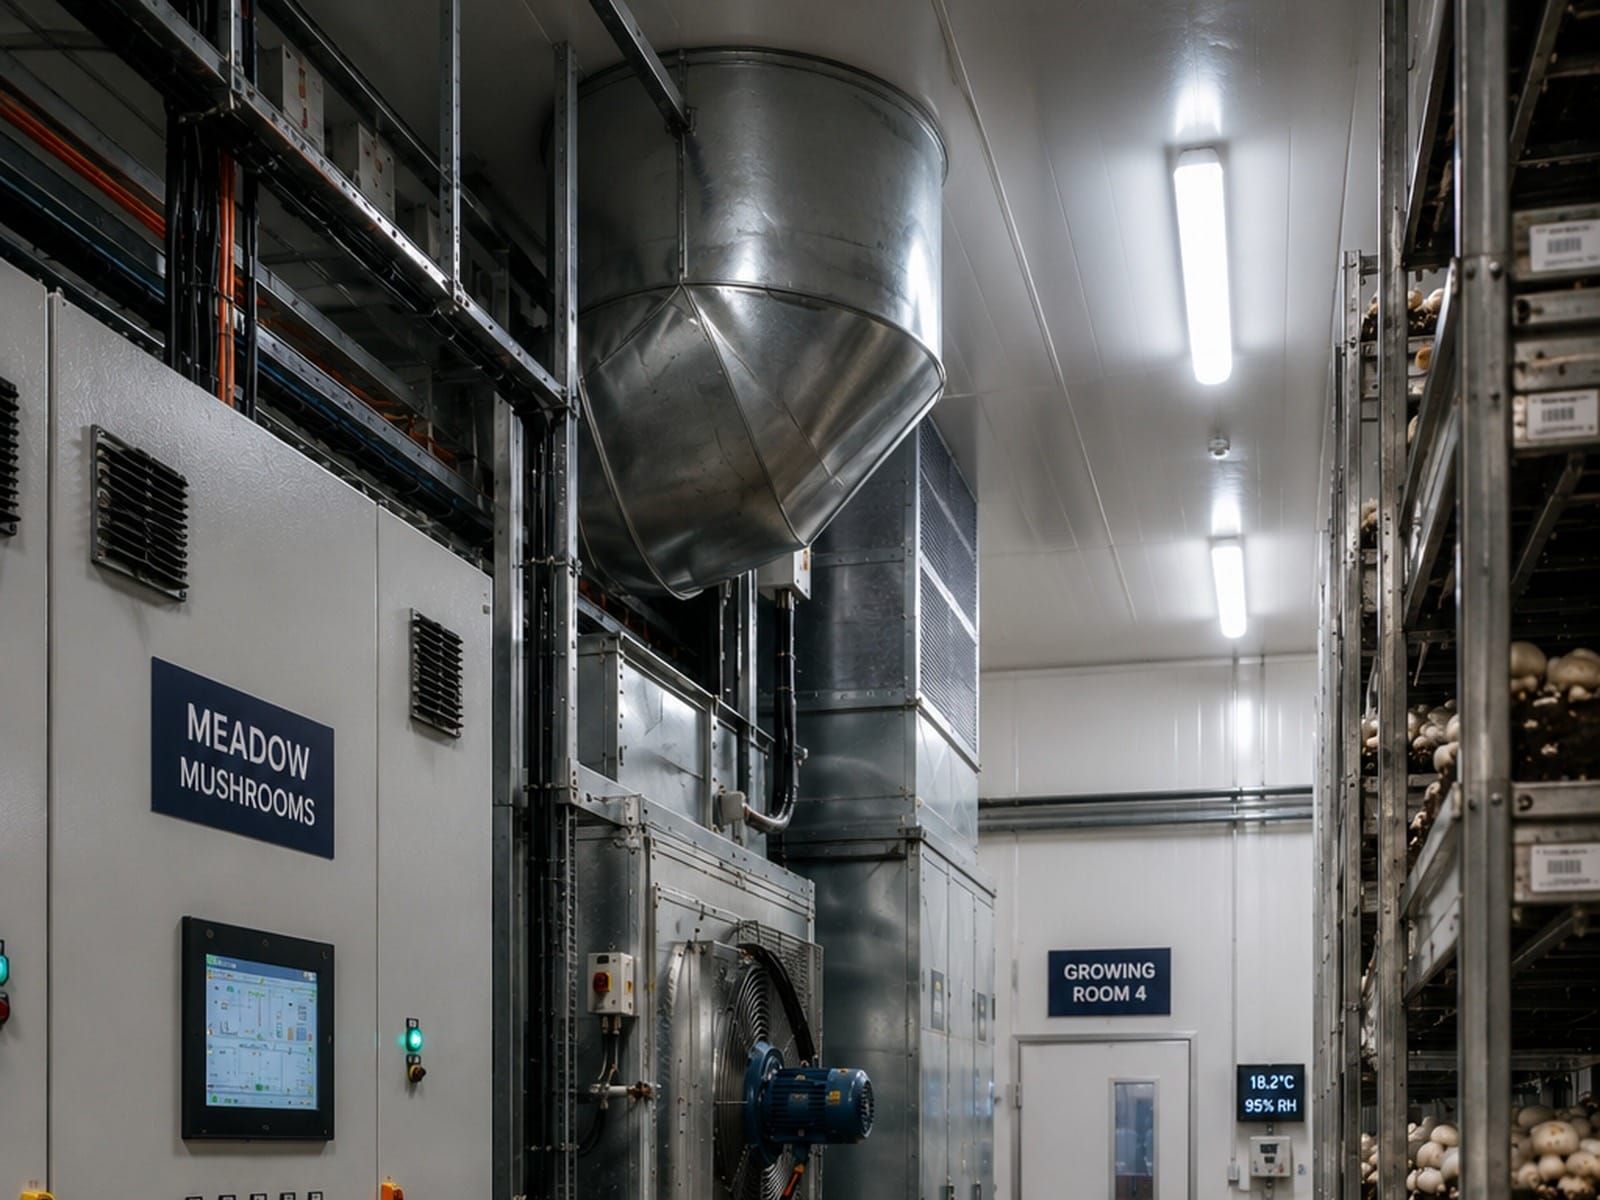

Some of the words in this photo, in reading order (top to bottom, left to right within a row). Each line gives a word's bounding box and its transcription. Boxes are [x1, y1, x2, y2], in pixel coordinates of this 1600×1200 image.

[187, 702, 310, 781] MEADOW
[180, 756, 316, 826] MUSHROOMS
[1063, 962, 1156, 980] GROWING
[1073, 985, 1130, 1002] ROOM
[1134, 985, 1147, 1001] 4
[1244, 1098, 1275, 1113] 95%
[1277, 1098, 1297, 1113] RH
